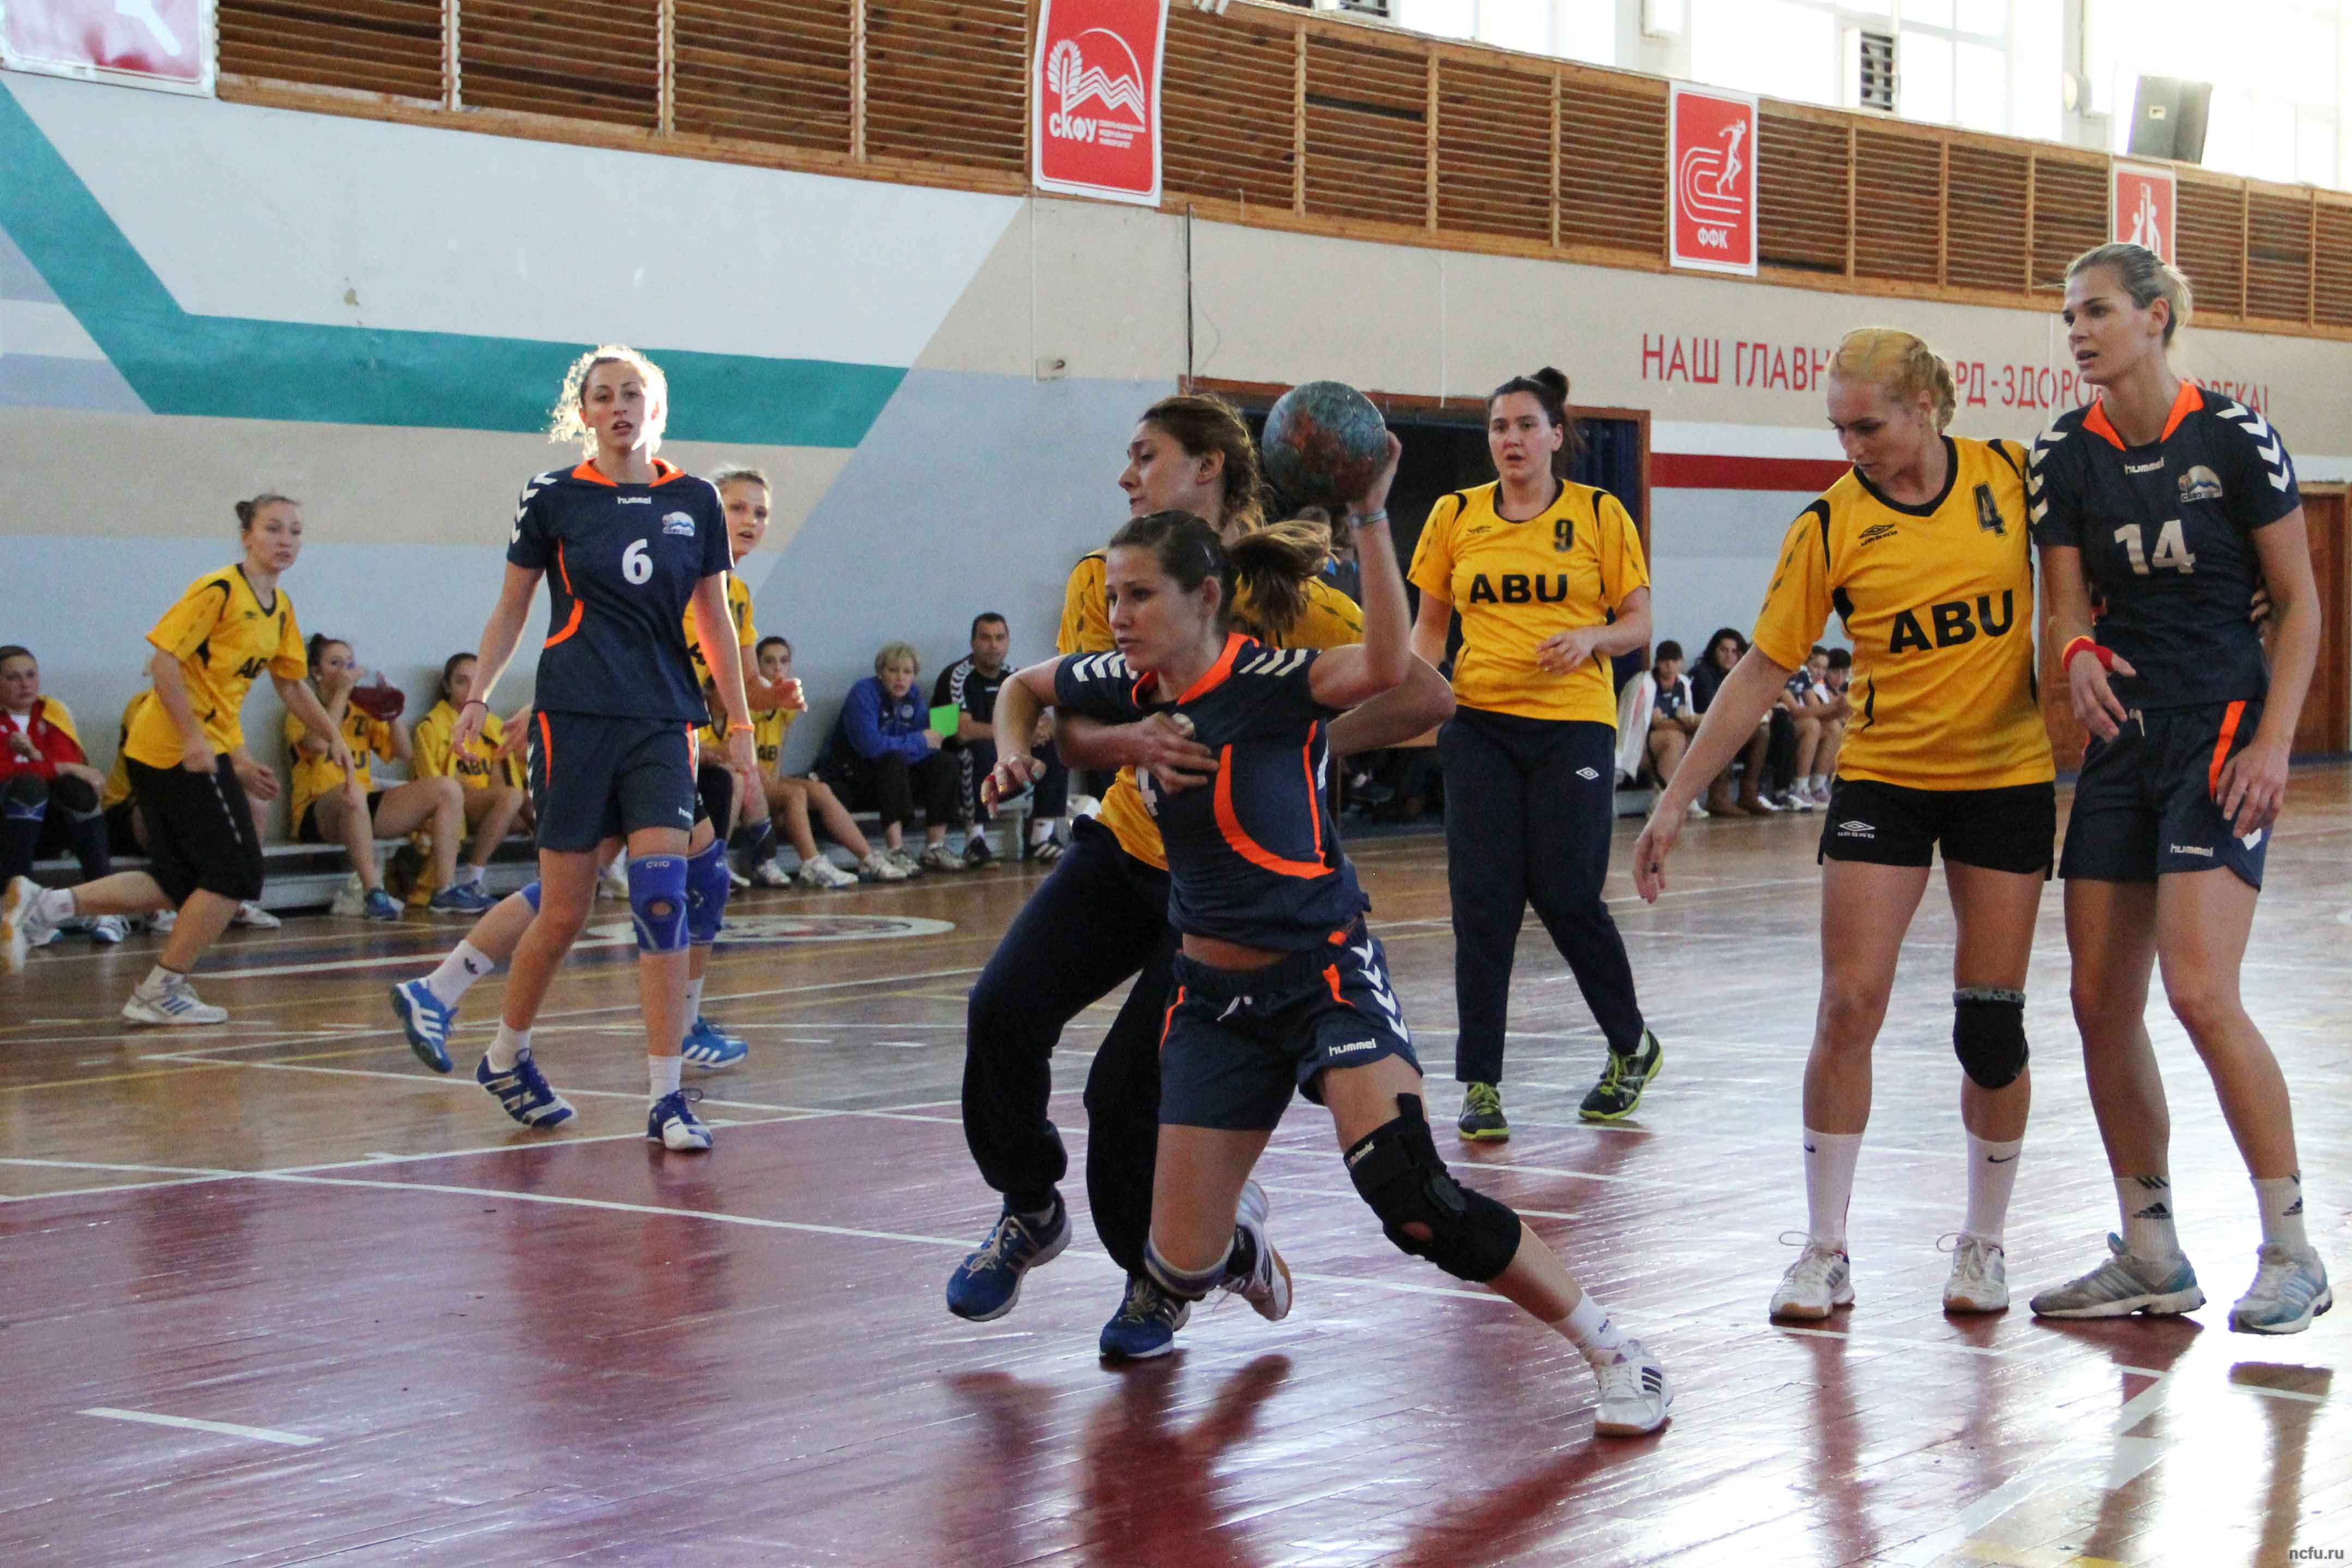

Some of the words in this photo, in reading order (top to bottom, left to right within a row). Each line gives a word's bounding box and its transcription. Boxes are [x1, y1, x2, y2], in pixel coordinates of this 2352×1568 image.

[1697, 227, 1728, 250] ФФК
[1642, 334, 1718, 384] НАШ
[1735, 341, 1831, 391] ГЛАВН
[1973, 481, 2007, 537] 4
[1553, 519, 1574, 552] 9
[2114, 519, 2196, 575] 14
[622, 539, 653, 584] 6
[1469, 574, 1567, 604] ABU
[1890, 589, 2013, 654] ABU
[1329, 1038, 1377, 1057] hummel
